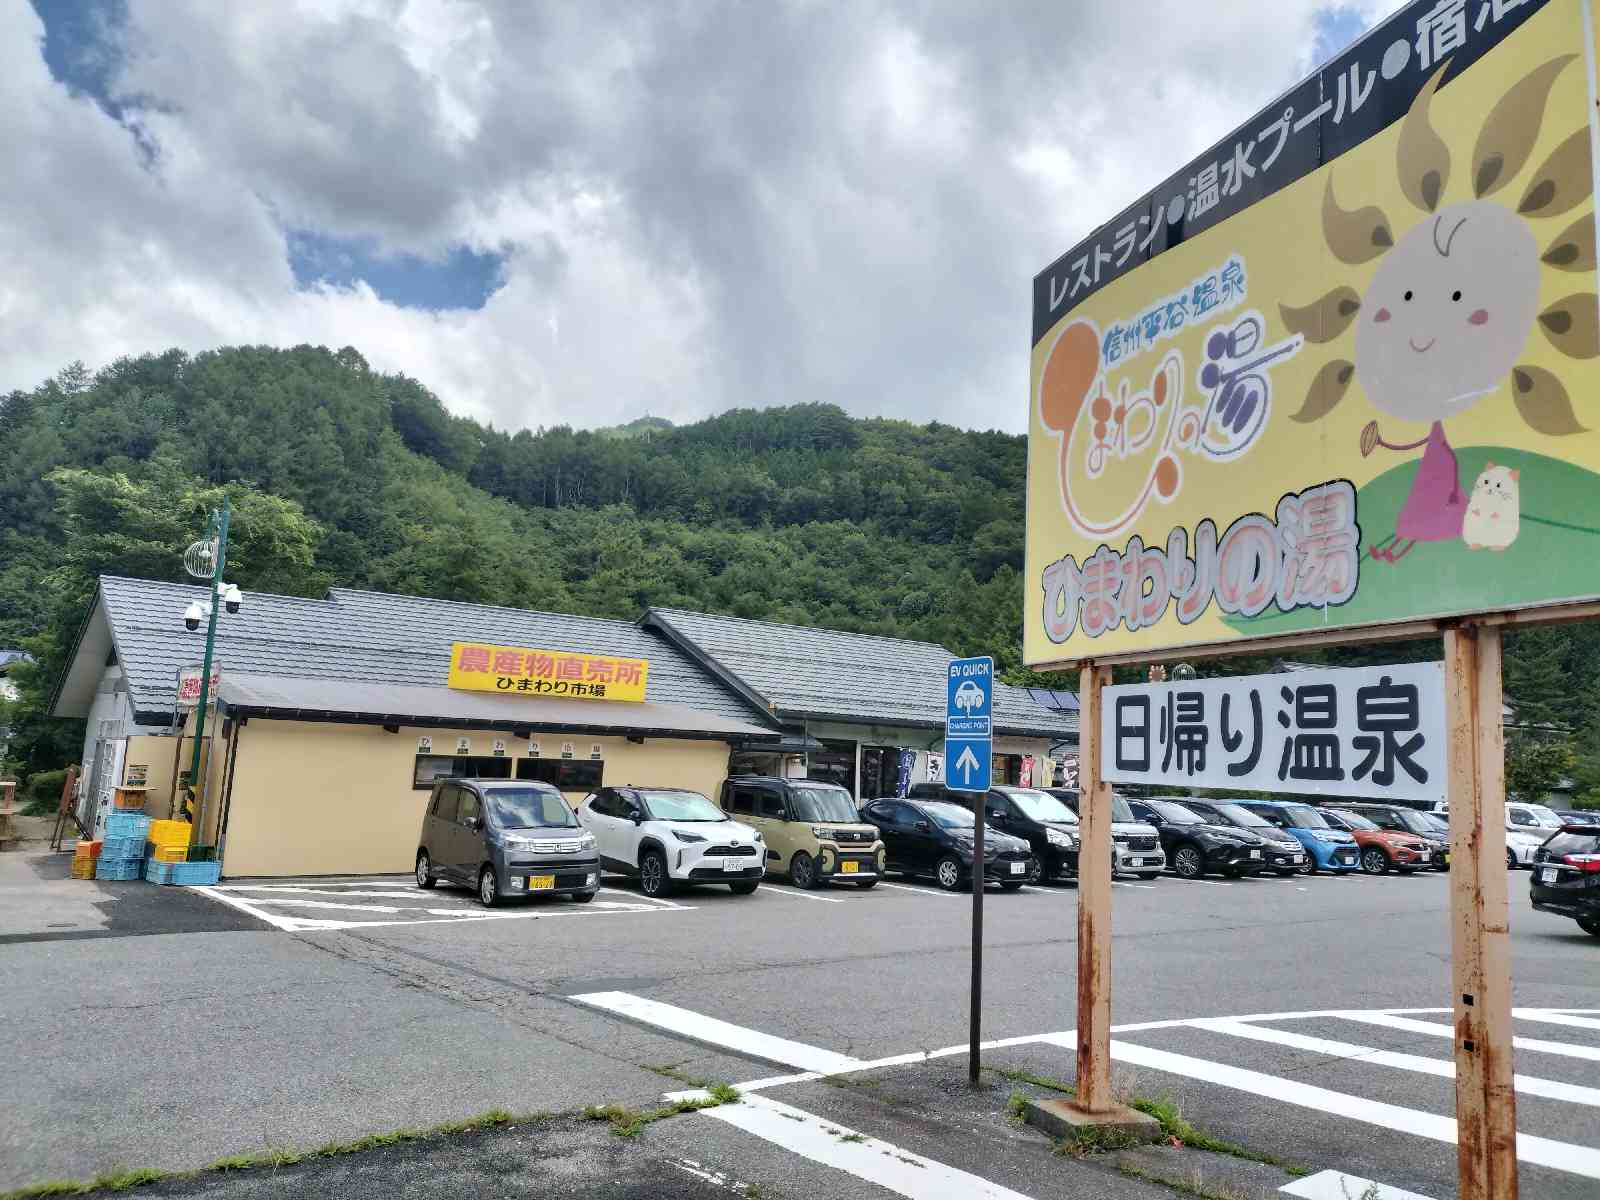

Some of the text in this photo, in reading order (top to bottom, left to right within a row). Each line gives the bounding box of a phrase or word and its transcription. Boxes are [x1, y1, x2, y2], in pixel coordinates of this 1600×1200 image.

[1043, 480, 1360, 642] ひまわりの湯
[458, 646, 643, 686] 農産物直売所
[950, 663, 989, 678] EV QUICK
[496, 677, 607, 697] ひまわり市場
[1115, 676, 1429, 786] 日帰り温泉
